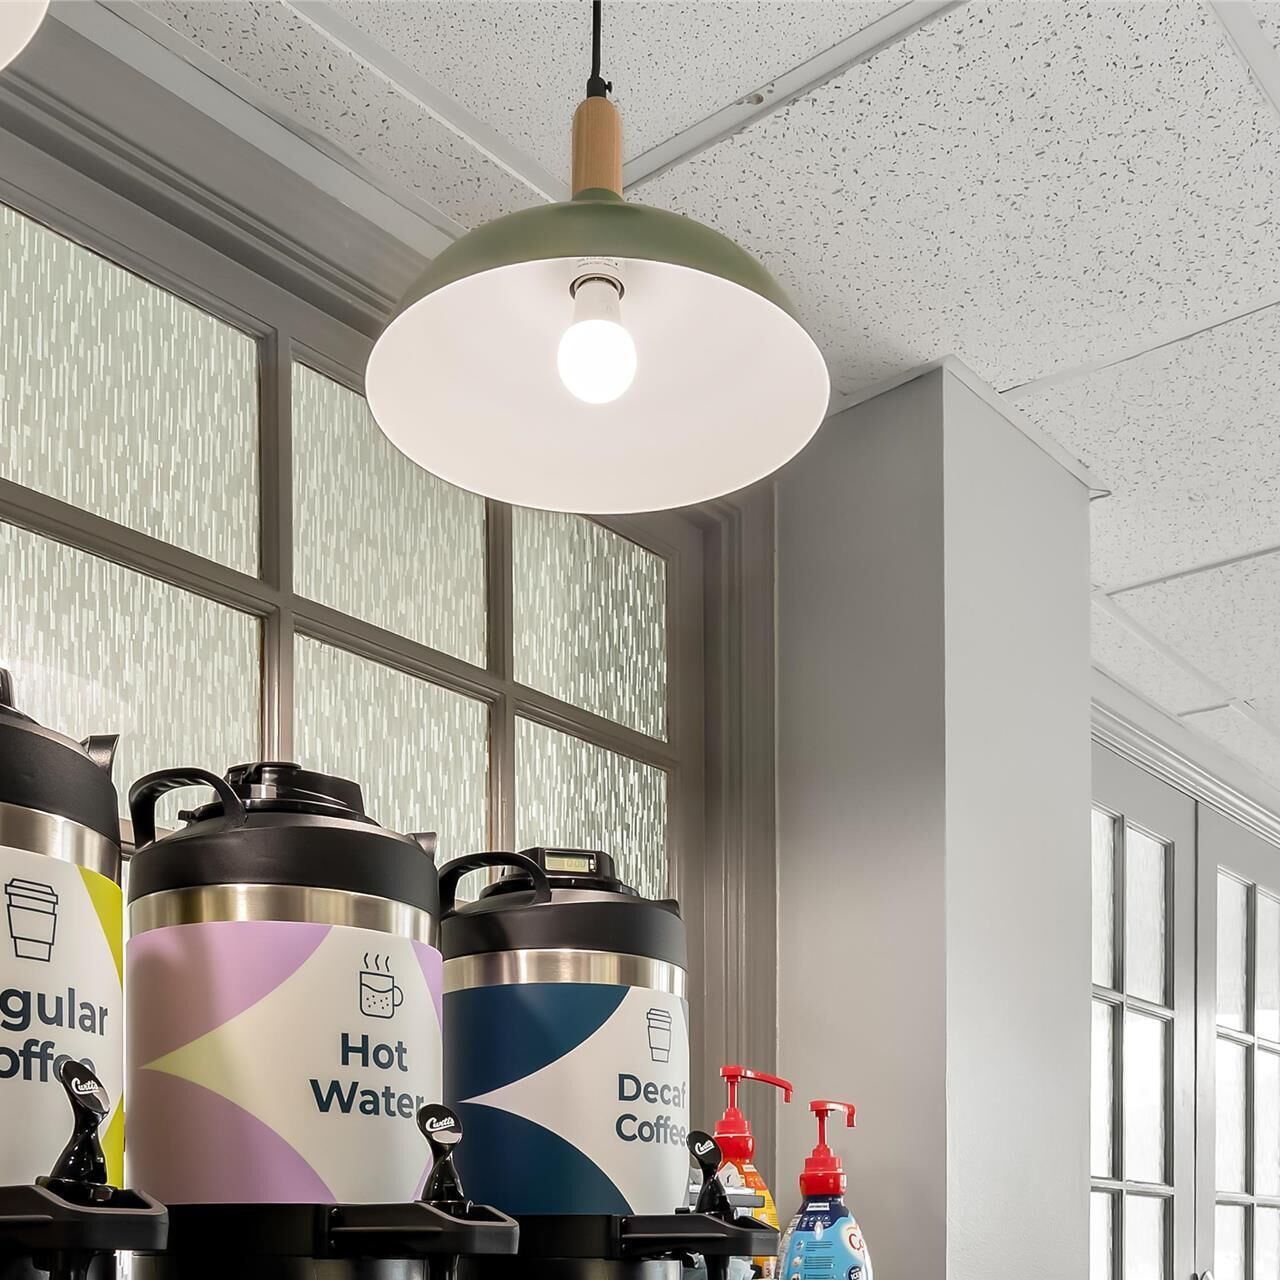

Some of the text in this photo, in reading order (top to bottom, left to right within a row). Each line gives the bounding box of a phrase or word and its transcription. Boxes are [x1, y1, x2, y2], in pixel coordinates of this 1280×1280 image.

[340, 1032, 409, 1072] Hot
[71, 1076, 100, 1096] Curtis
[617, 1073, 687, 1109] Decaf
[425, 1116, 456, 1132] Curtis
[615, 1113, 687, 1147] Coffee
